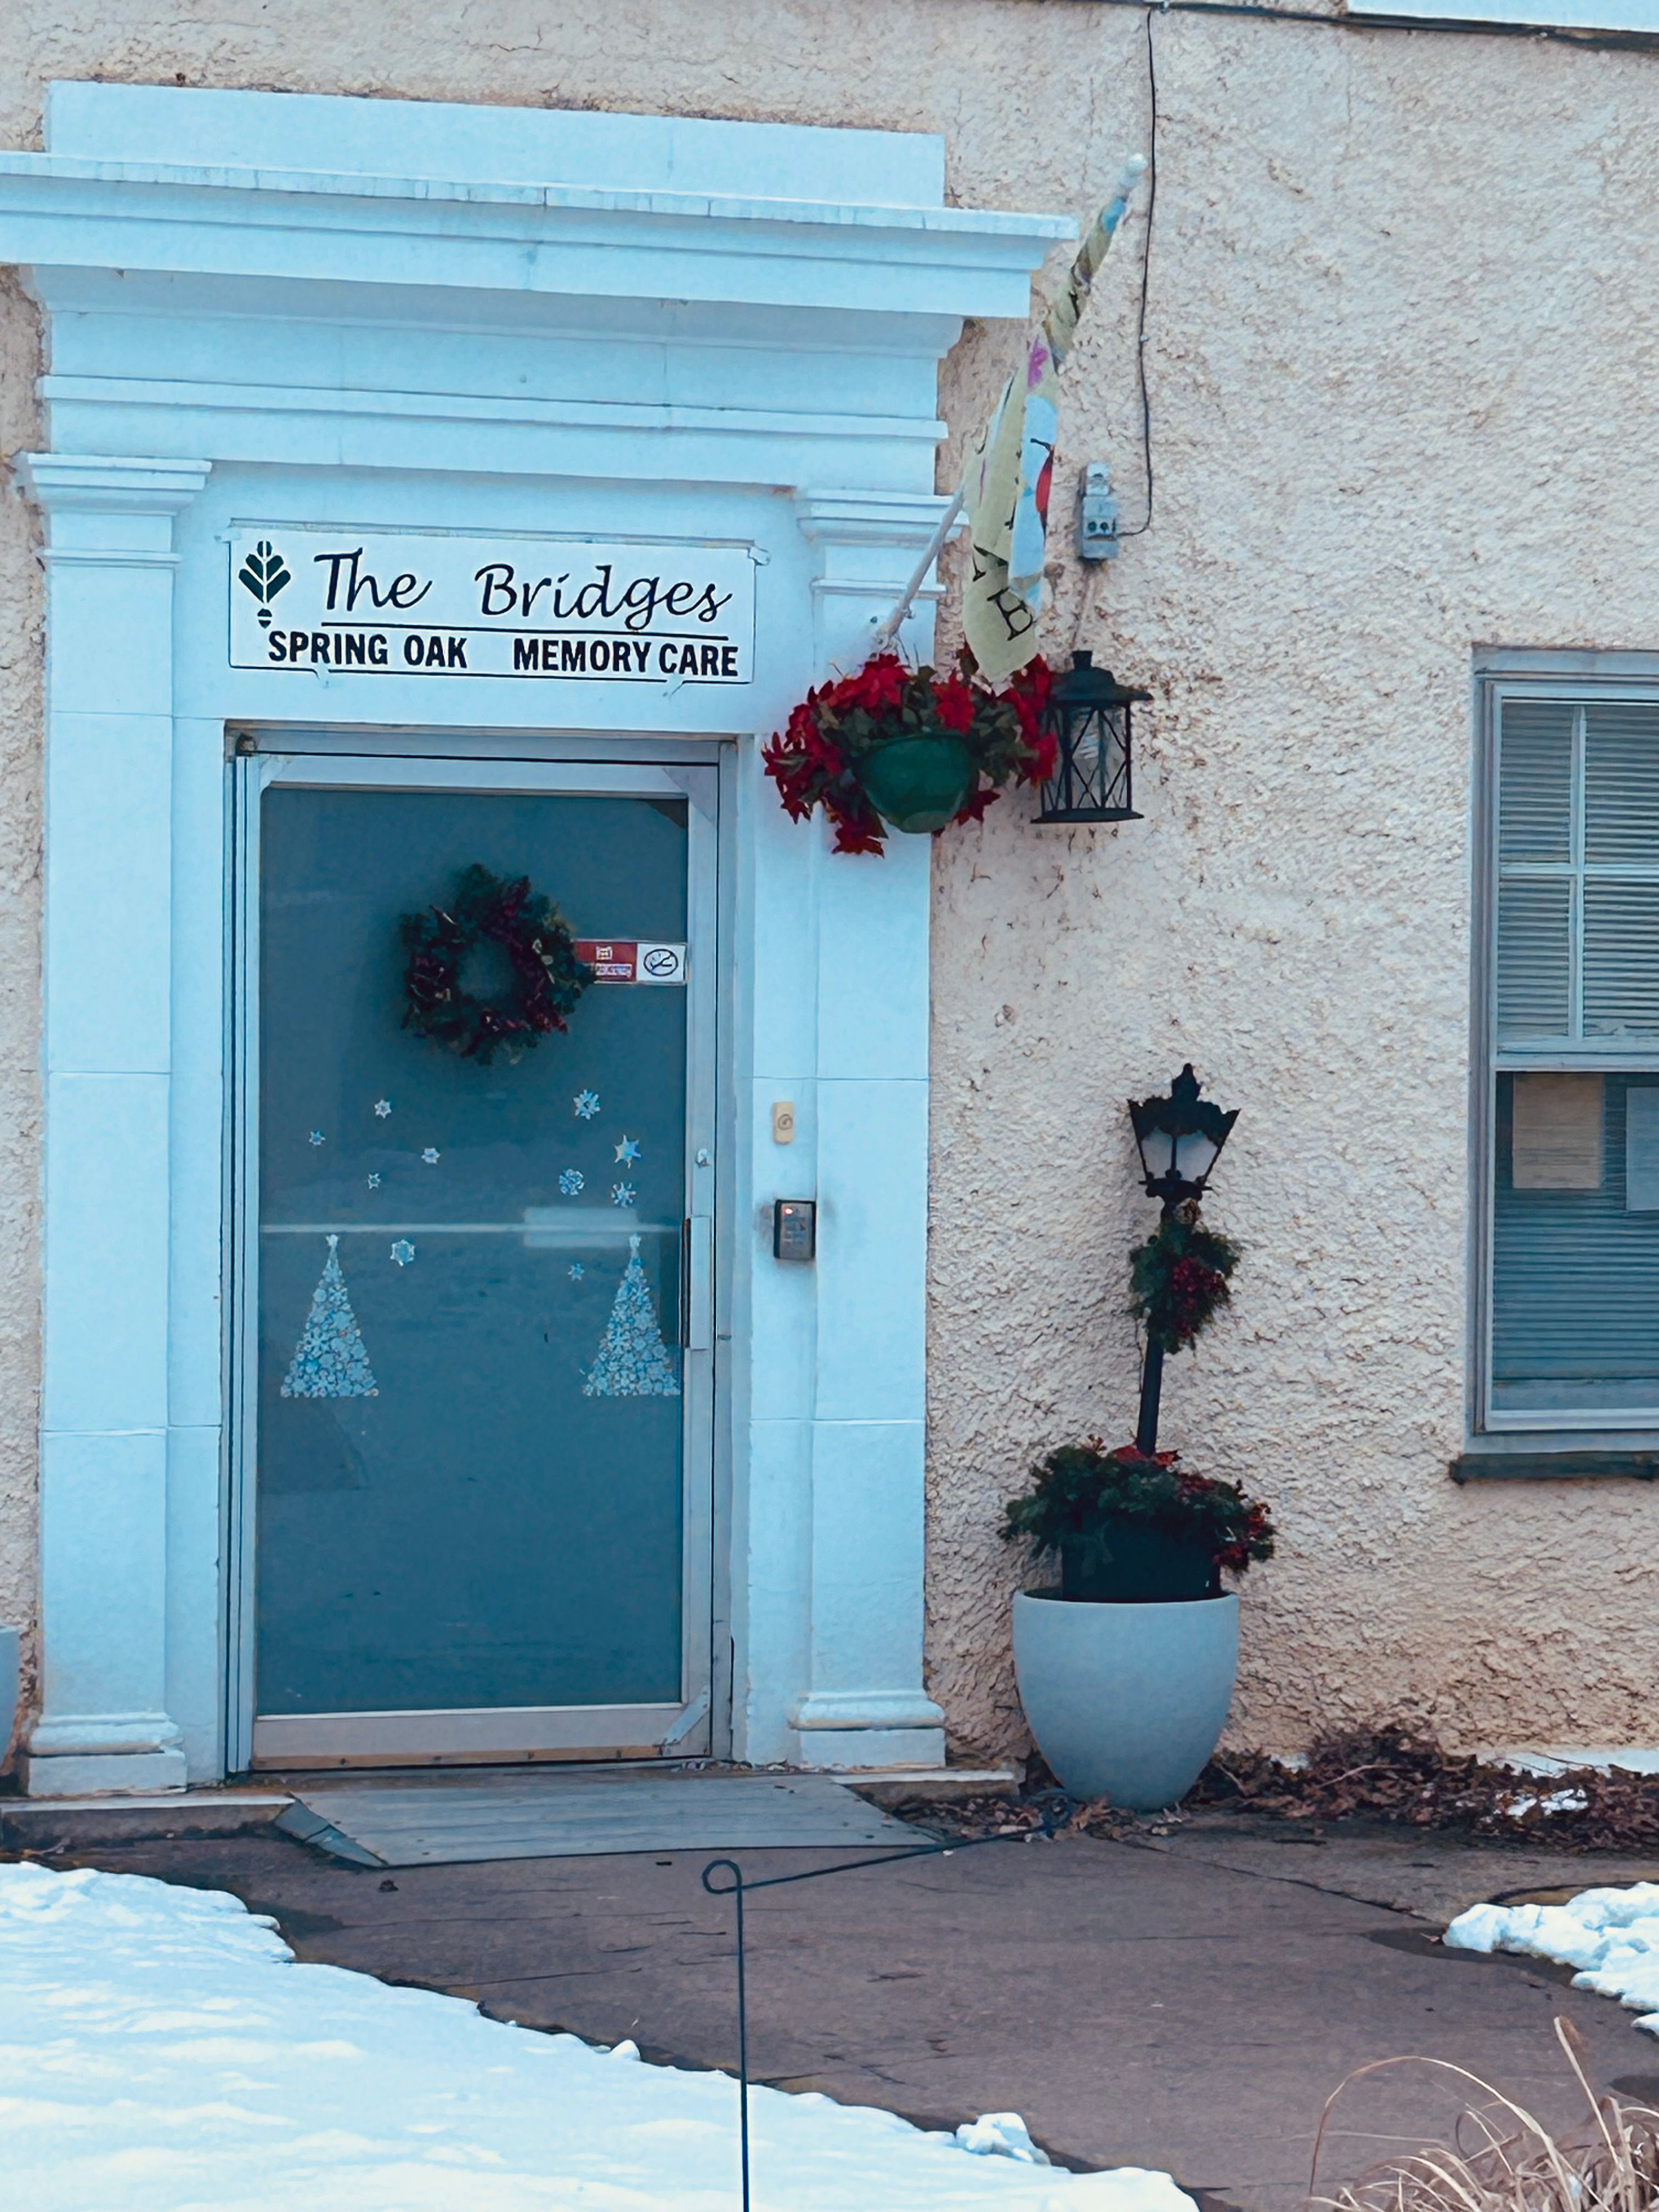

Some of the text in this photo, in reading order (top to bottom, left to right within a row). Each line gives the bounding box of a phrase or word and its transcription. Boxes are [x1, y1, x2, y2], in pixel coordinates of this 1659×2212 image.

[313, 547, 732, 631] The Bridges
[268, 631, 738, 676] SPRING OAK MEMORY CARE
